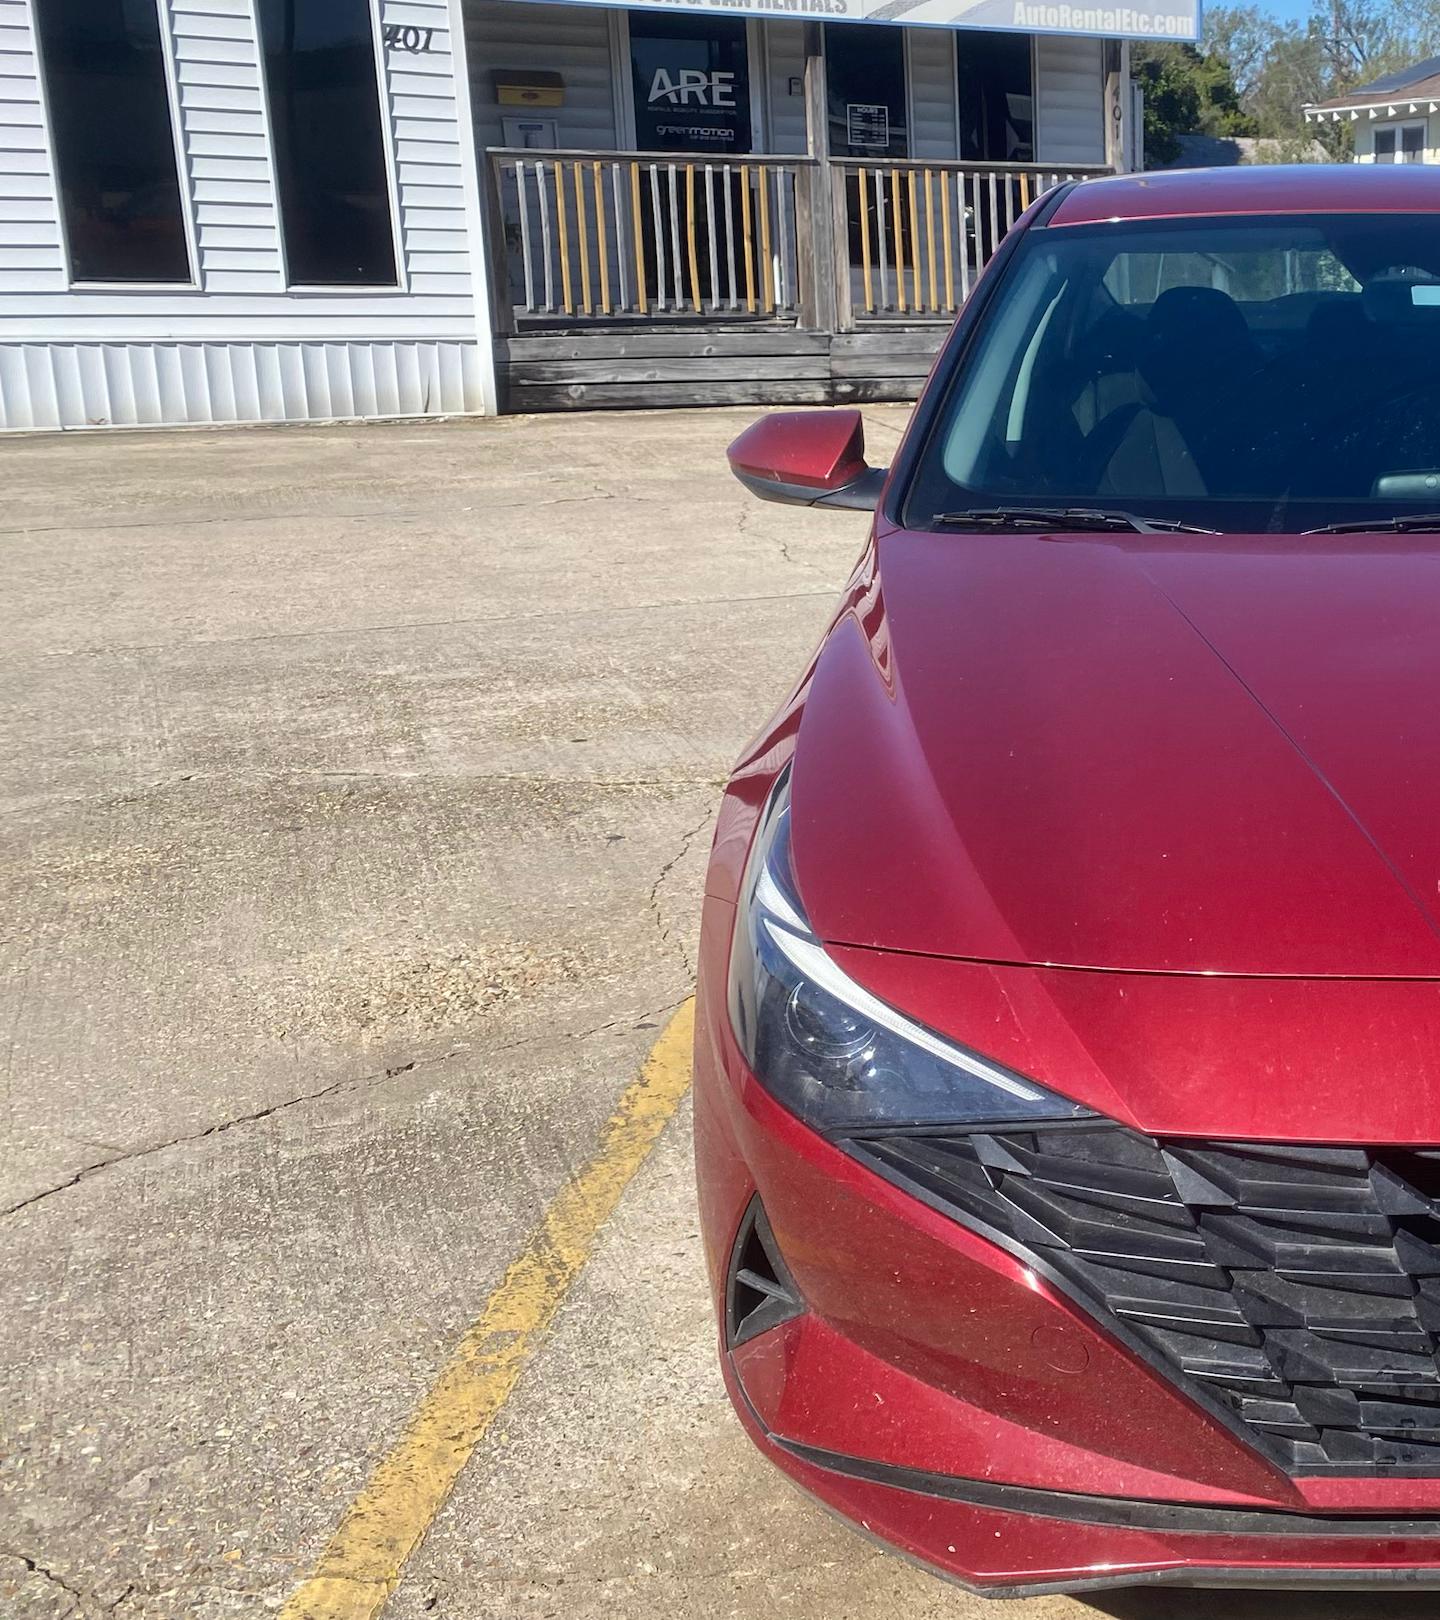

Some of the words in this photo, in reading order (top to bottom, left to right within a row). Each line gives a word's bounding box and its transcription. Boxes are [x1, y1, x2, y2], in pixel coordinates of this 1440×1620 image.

[1013, 2, 1193, 36] AutoRentalEtc.com
[384, 25, 433, 51] 401
[647, 68, 737, 107] ARE
